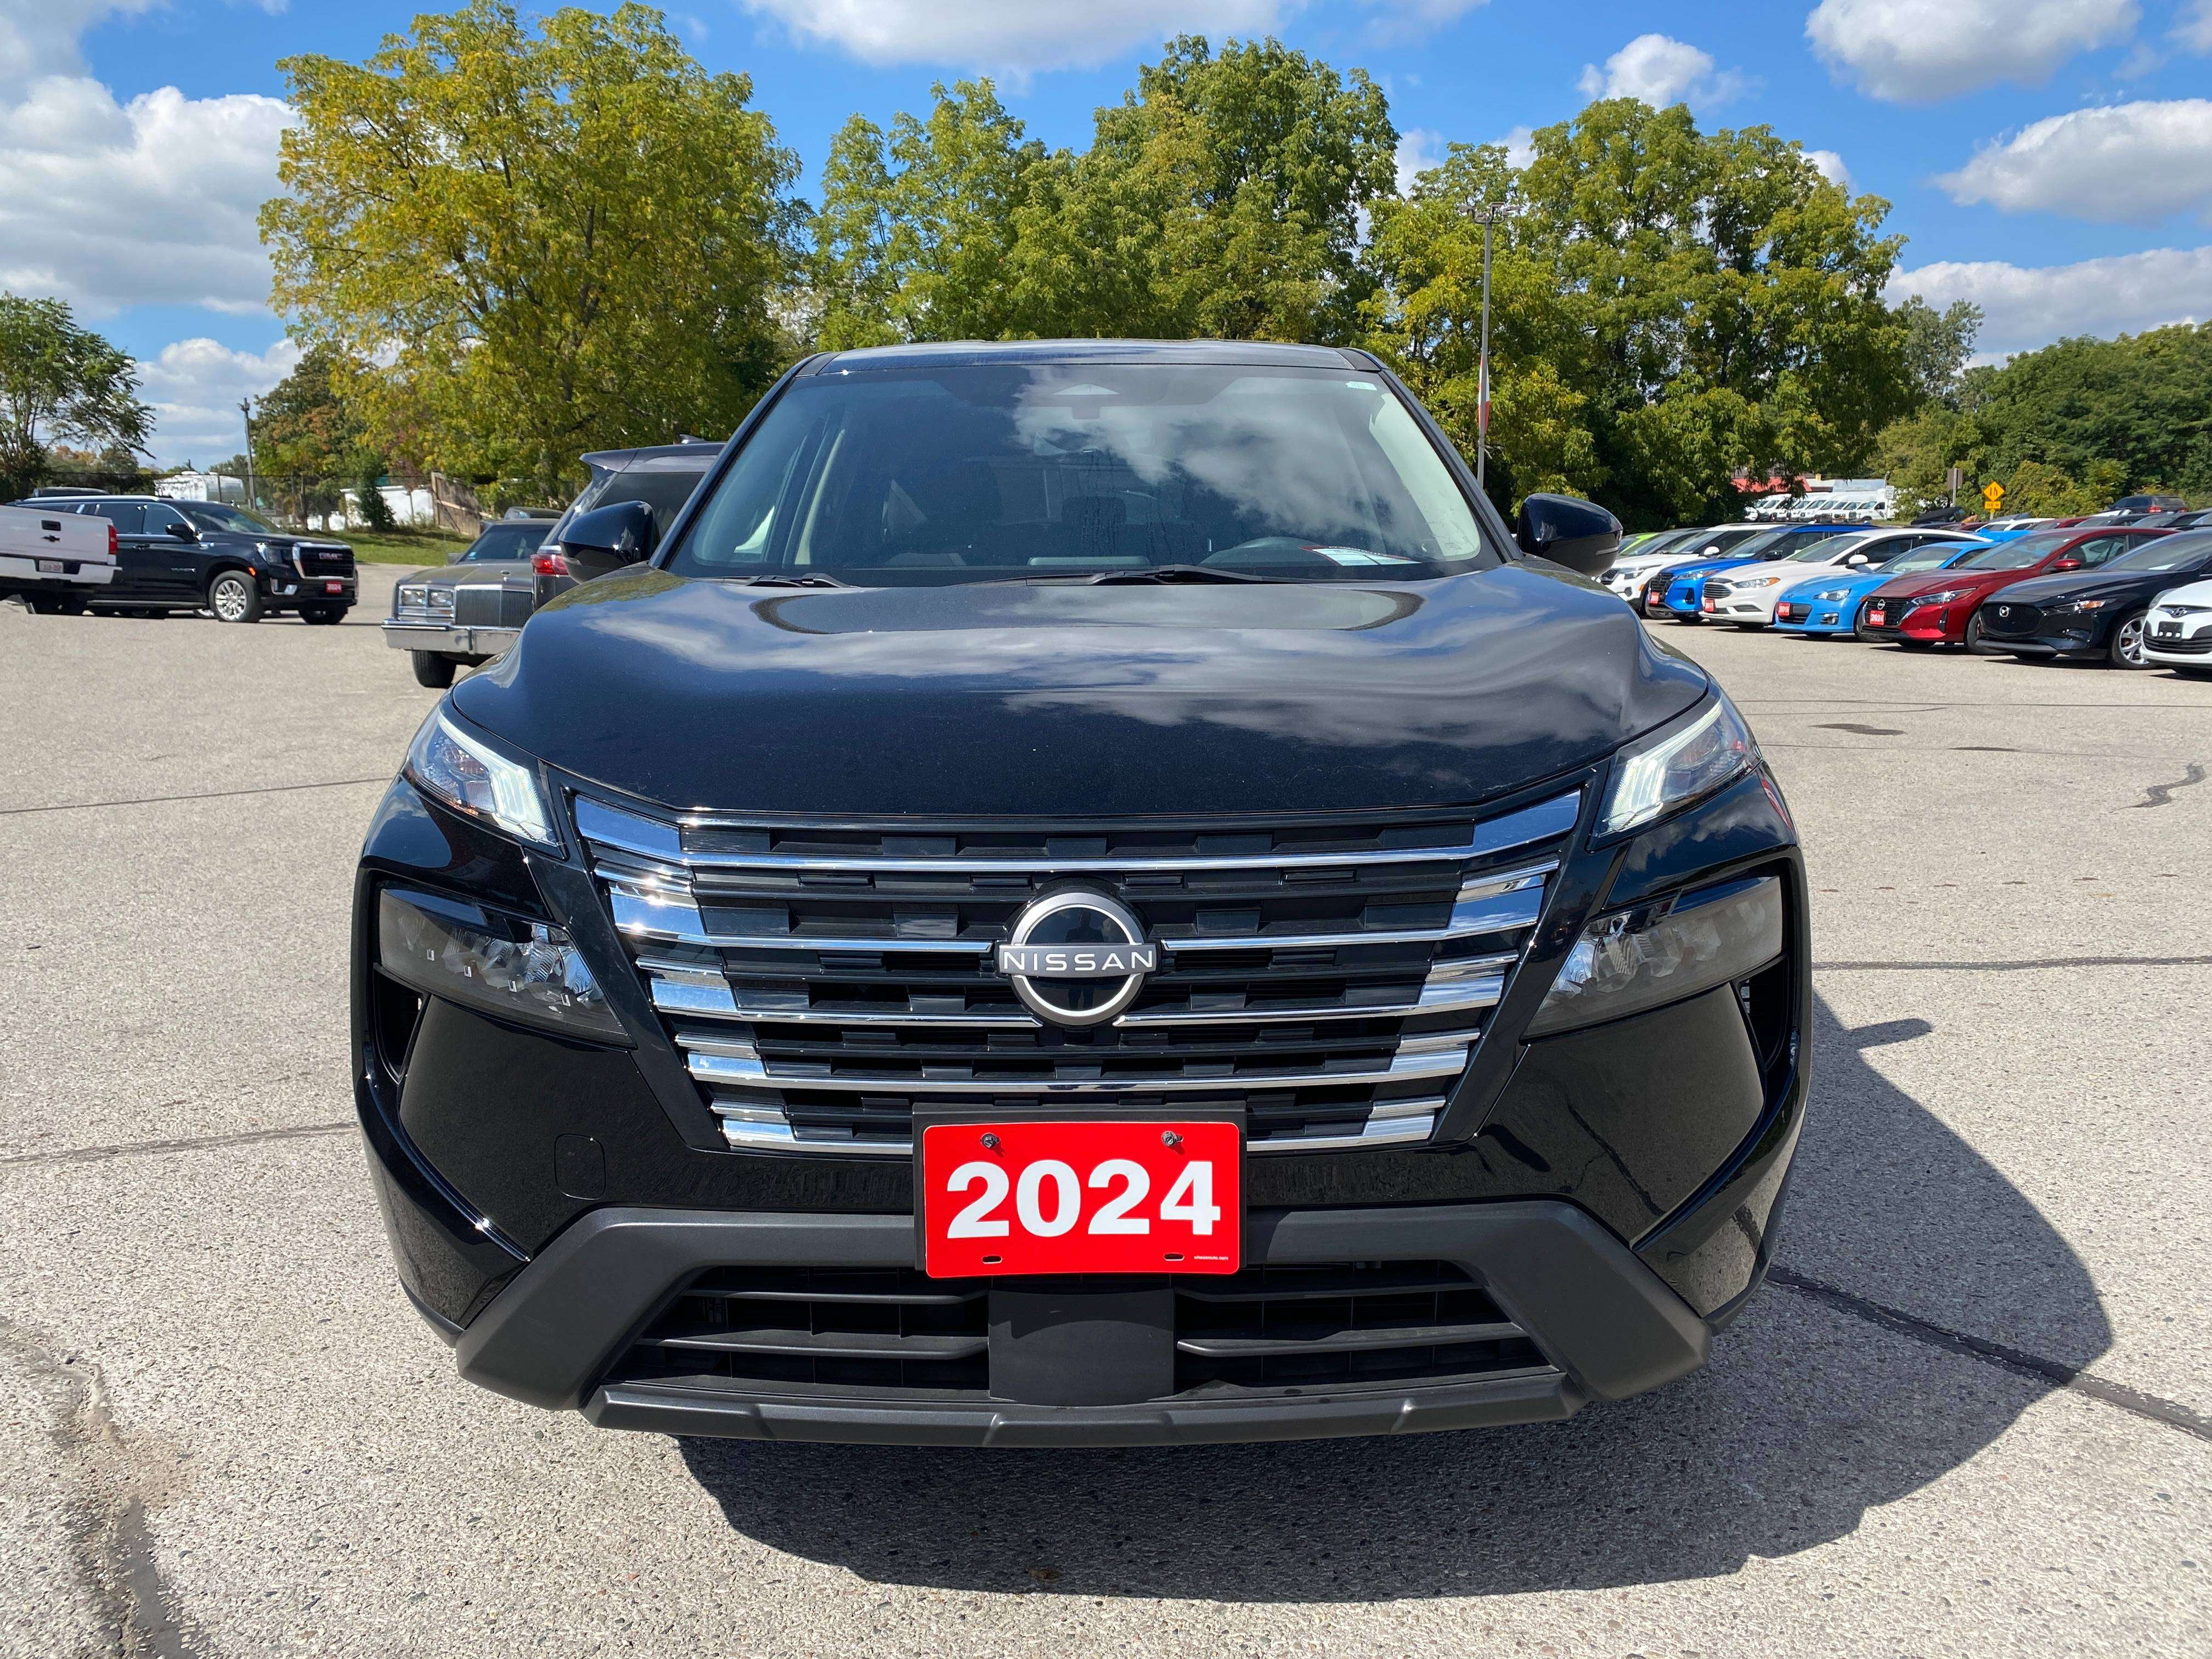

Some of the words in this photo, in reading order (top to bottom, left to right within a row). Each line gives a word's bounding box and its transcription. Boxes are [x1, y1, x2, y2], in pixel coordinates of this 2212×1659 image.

[1871, 613, 1884, 622] 2024
[1003, 951, 1153, 972] NISSAN
[946, 1159, 1221, 1239] 2024
